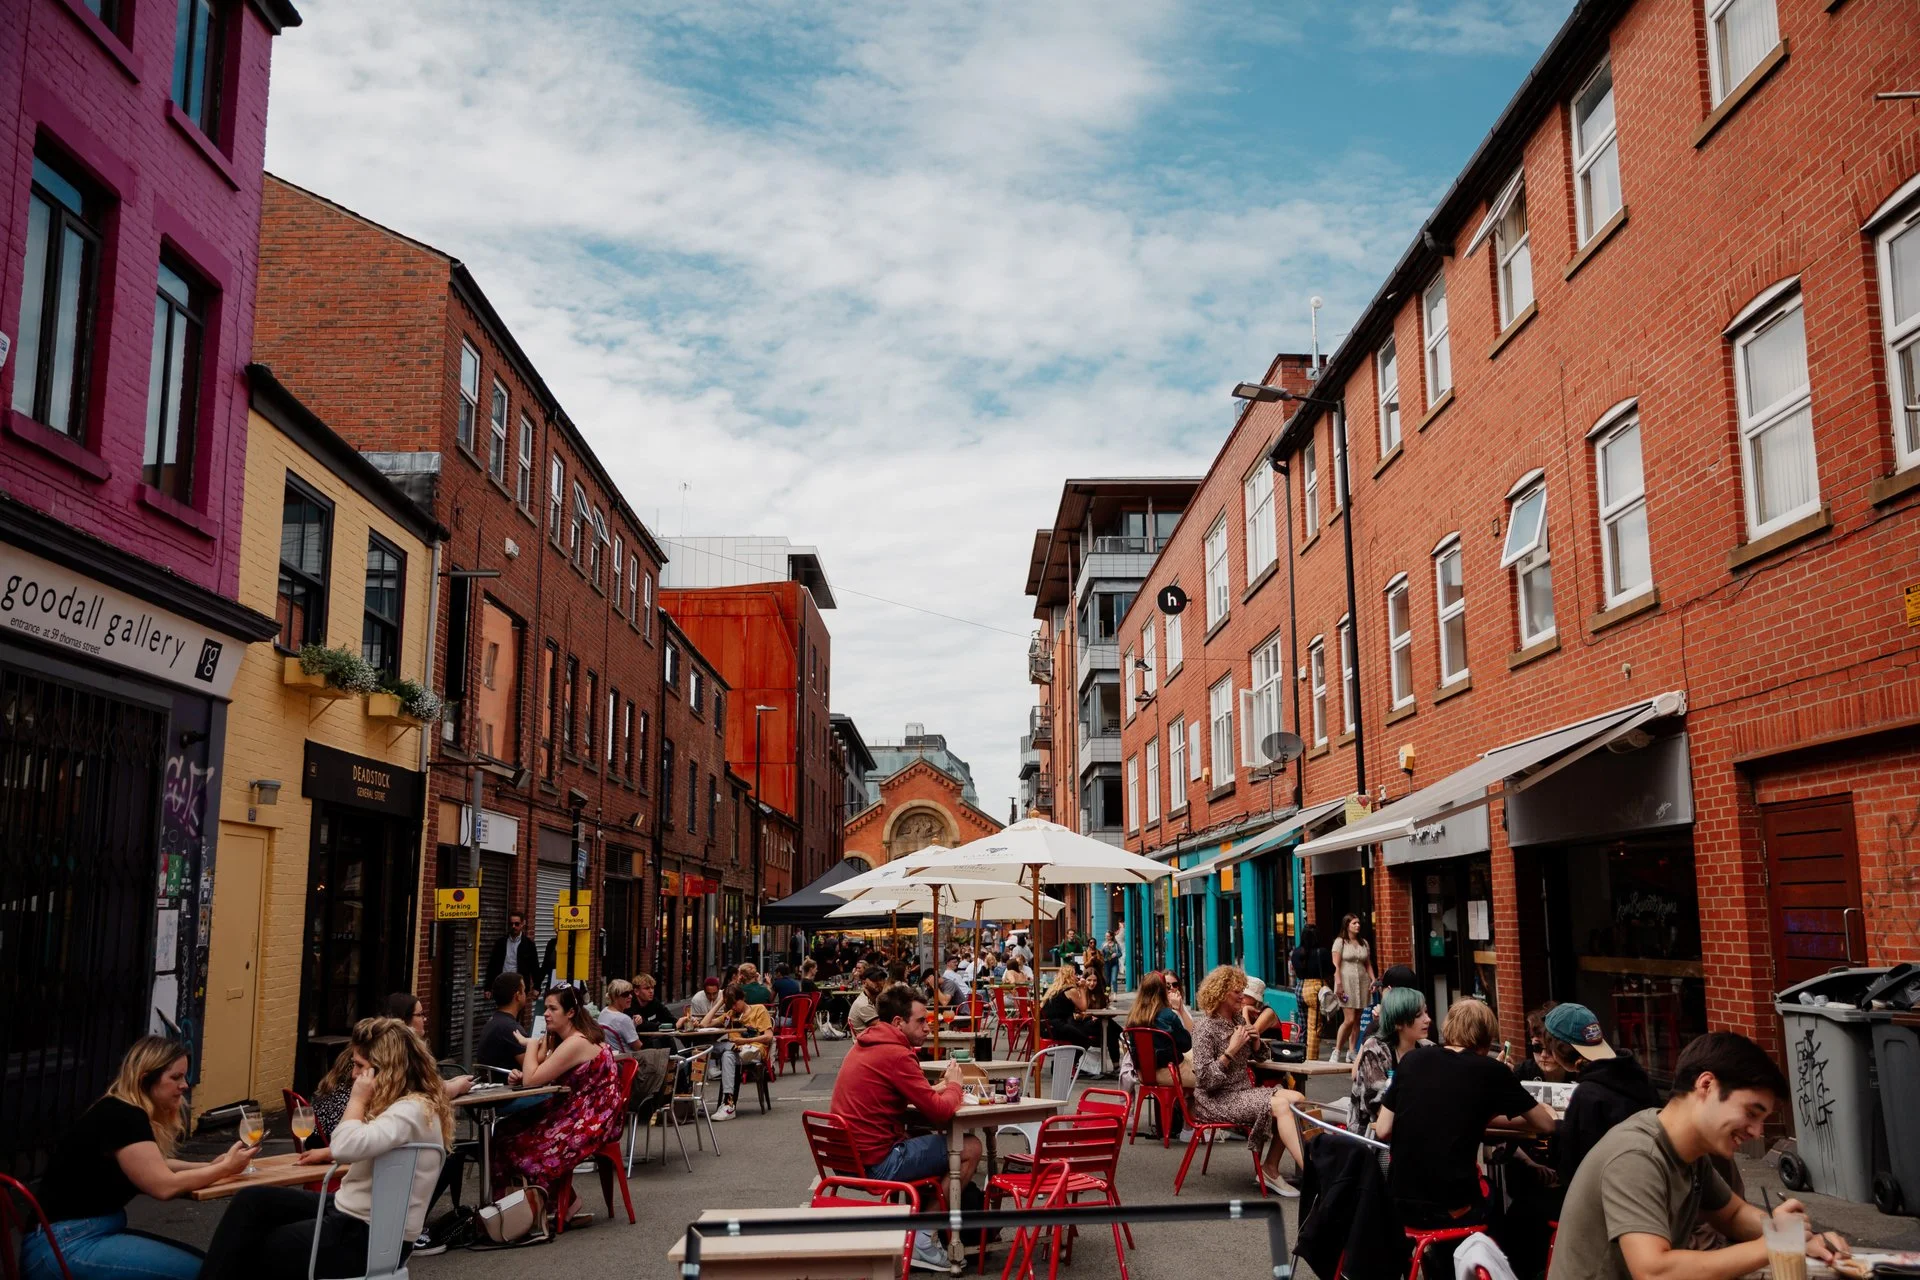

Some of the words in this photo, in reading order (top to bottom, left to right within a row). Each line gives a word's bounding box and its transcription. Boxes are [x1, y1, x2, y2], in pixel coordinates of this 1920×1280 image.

[0, 575, 104, 630] goodall
[104, 614, 185, 668] gallery
[10, 616, 40, 635] entrance
[42, 628, 50, 637] at
[50, 627, 60, 640] 59
[59, 632, 82, 649] thomas
[82, 641, 101, 655] street
[200, 643, 219, 677] rg
[352, 764, 391, 789] DEADSTOCK
[356, 781, 374, 799] GENERAL
[374, 789, 386, 802] STORE
[446, 903, 471, 911] Parking
[560, 922, 589, 930] Suspension
